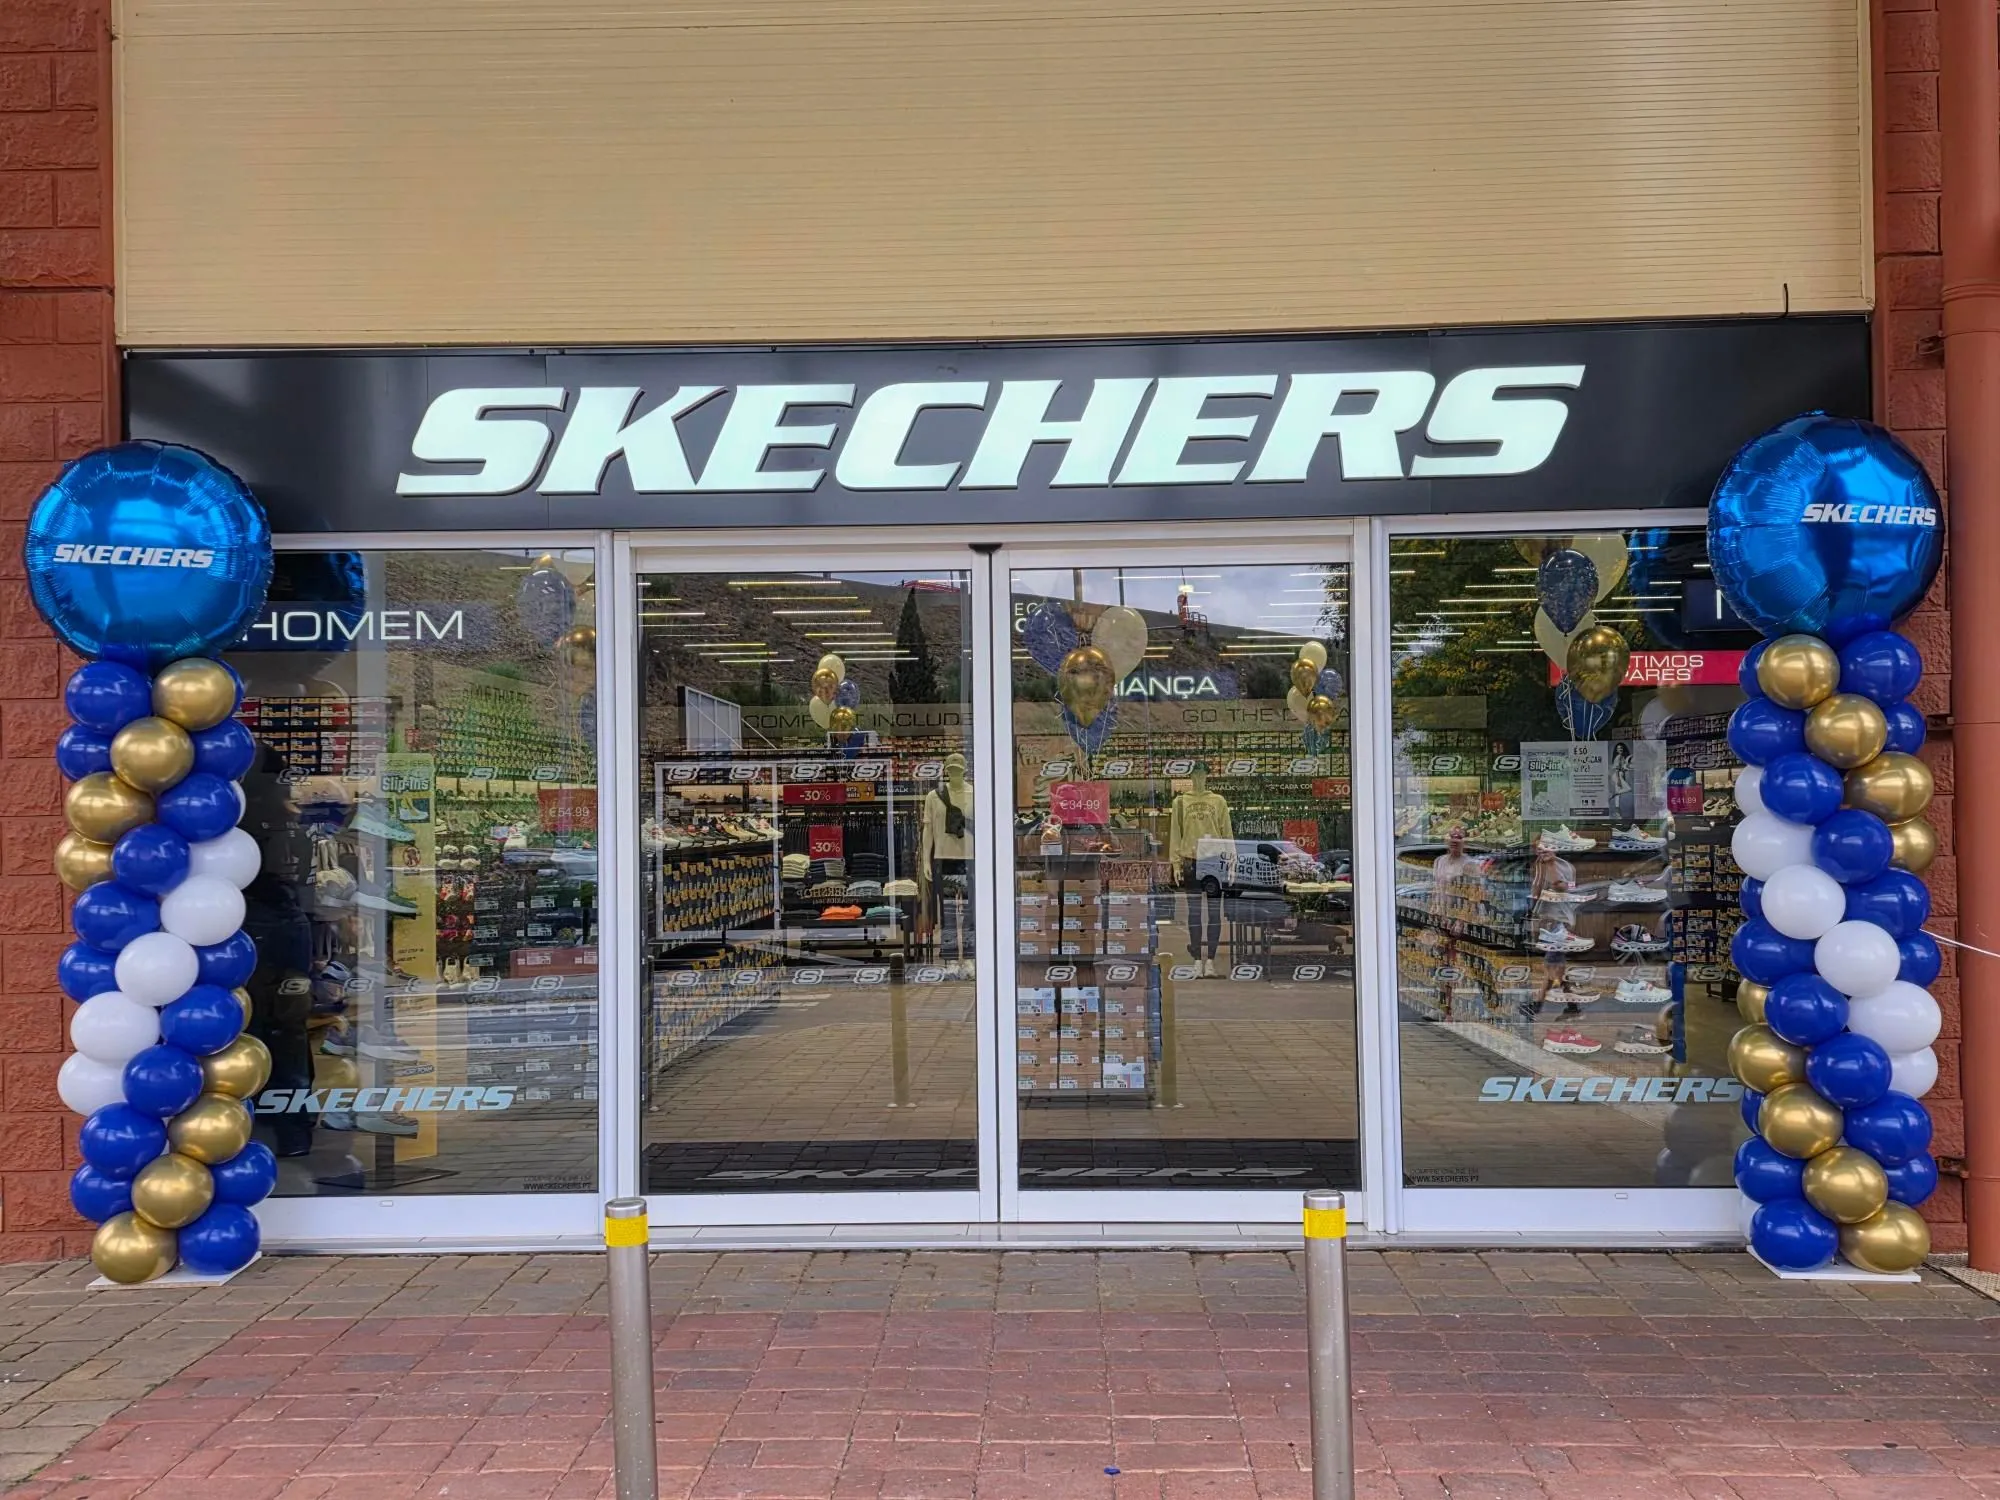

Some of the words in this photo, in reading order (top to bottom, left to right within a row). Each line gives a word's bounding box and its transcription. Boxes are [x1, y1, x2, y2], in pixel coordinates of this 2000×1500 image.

[396, 365, 1586, 496] SKECHERS
[1800, 503, 1937, 526] SKECHERS
[53, 544, 216, 568] SKECHERS
[242, 610, 463, 641] HOMEM
[1628, 655, 1704, 669] TIMOS
[1113, 676, 1220, 699] IANÇA
[744, 712, 865, 729] COMFT
[1182, 708, 1218, 723] GO
[1227, 707, 1274, 722] THE
[799, 789, 831, 802] -30%
[1329, 784, 1350, 796] -30
[549, 806, 590, 818] €54.99
[1061, 799, 1101, 810] €34.99
[811, 841, 841, 853] -30%
[1478, 1077, 1744, 1102] SKECHERS
[255, 1086, 518, 1114] SKECHERS
